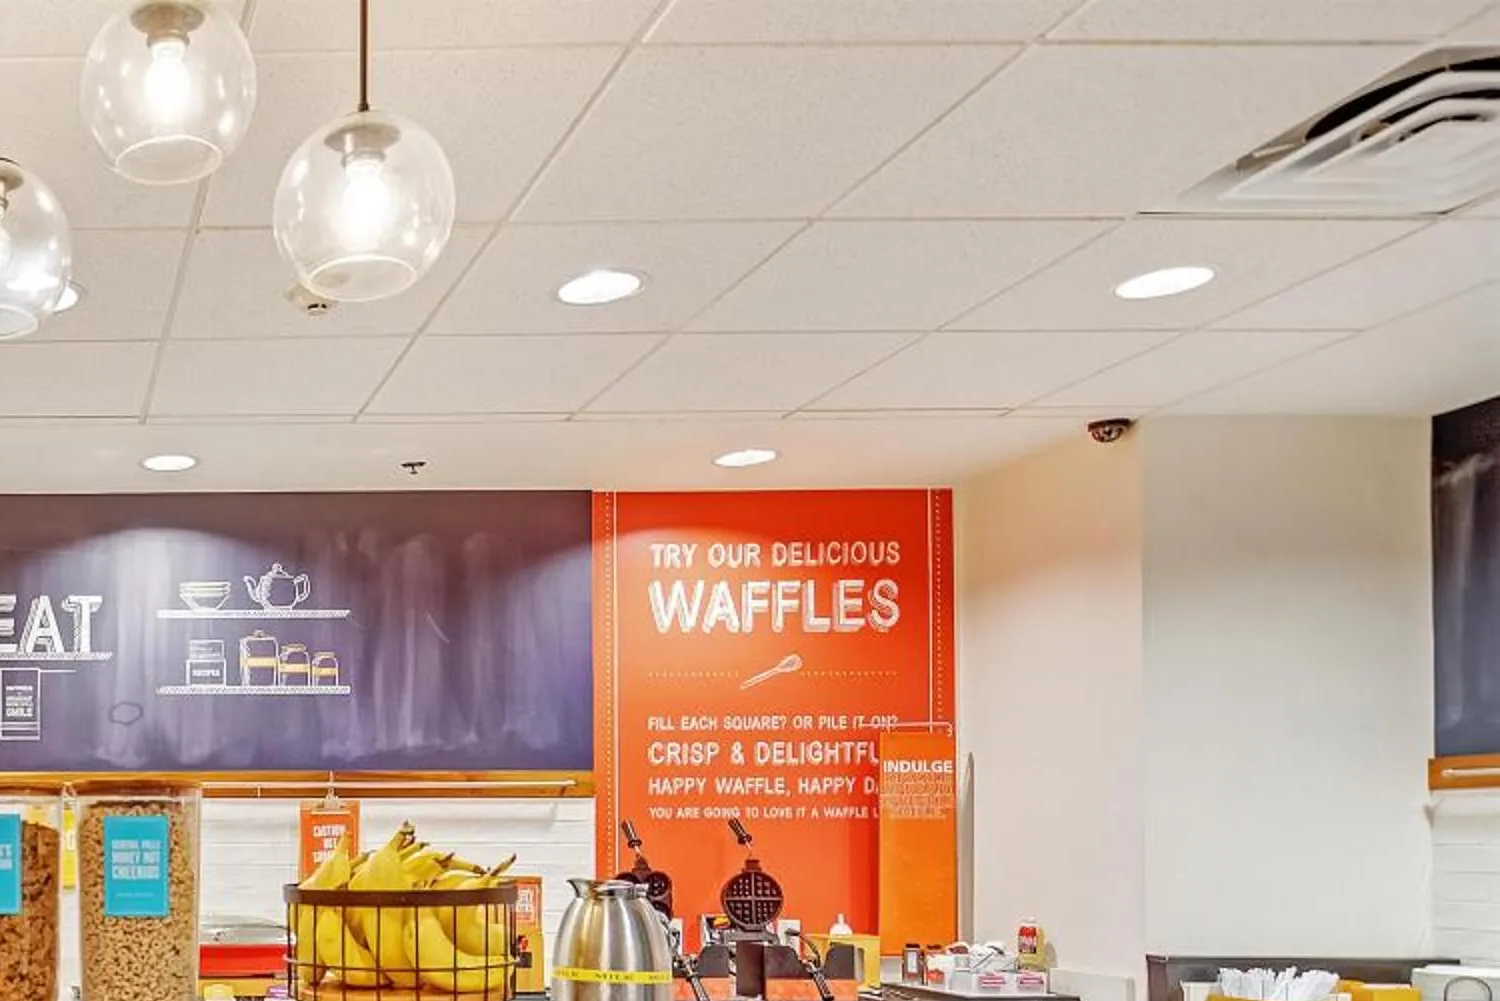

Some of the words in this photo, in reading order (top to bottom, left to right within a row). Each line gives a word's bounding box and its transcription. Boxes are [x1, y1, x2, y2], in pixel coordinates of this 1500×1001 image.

[651, 543, 698, 568] TRY
[707, 542, 761, 568] OUR
[771, 541, 900, 567] DELICIOUS
[648, 578, 900, 634] WAFFLES
[647, 716, 675, 731] FILL
[680, 716, 717, 731] EACH
[723, 715, 787, 731] SQUARE?
[793, 715, 812, 730] OR
[818, 715, 847, 730] PILE
[853, 715, 865, 730] IT
[648, 741, 720, 766] CRISP
[730, 741, 745, 765] &
[883, 759, 954, 773] INDULGE
[648, 777, 707, 796] HAPPY
[715, 776, 792, 797] WAFFLE,
[798, 776, 856, 795] HAPPY
[649, 807, 672, 820] YOU
[676, 807, 701, 820] ARE
[704, 807, 740, 819] GOING
[746, 807, 759, 819] TO
[764, 807, 793, 819] LOVE
[823, 806, 869, 819] WAFFLE
